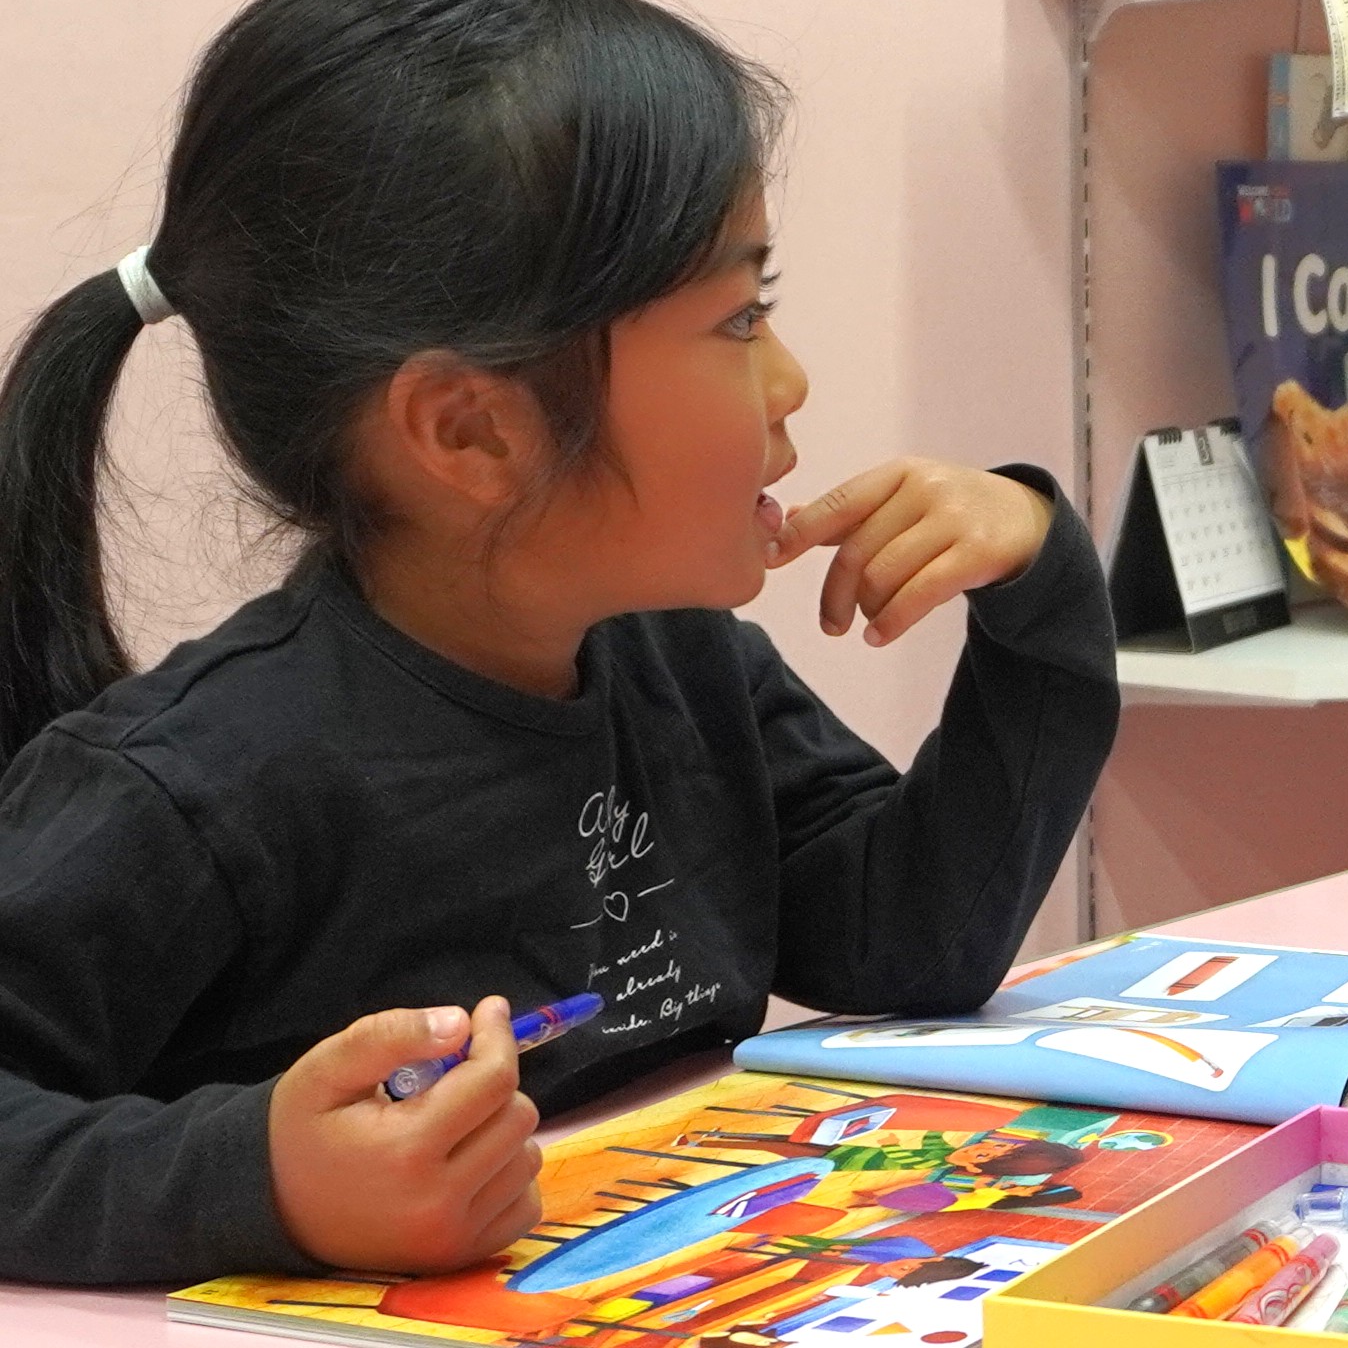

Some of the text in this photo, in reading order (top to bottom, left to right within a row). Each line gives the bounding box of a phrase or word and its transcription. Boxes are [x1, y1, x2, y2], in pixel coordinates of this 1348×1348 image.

[1262, 254, 1277, 338] I
[617, 929, 664, 965] need
[616, 959, 681, 1002] already
[659, 998, 683, 1021] Big
